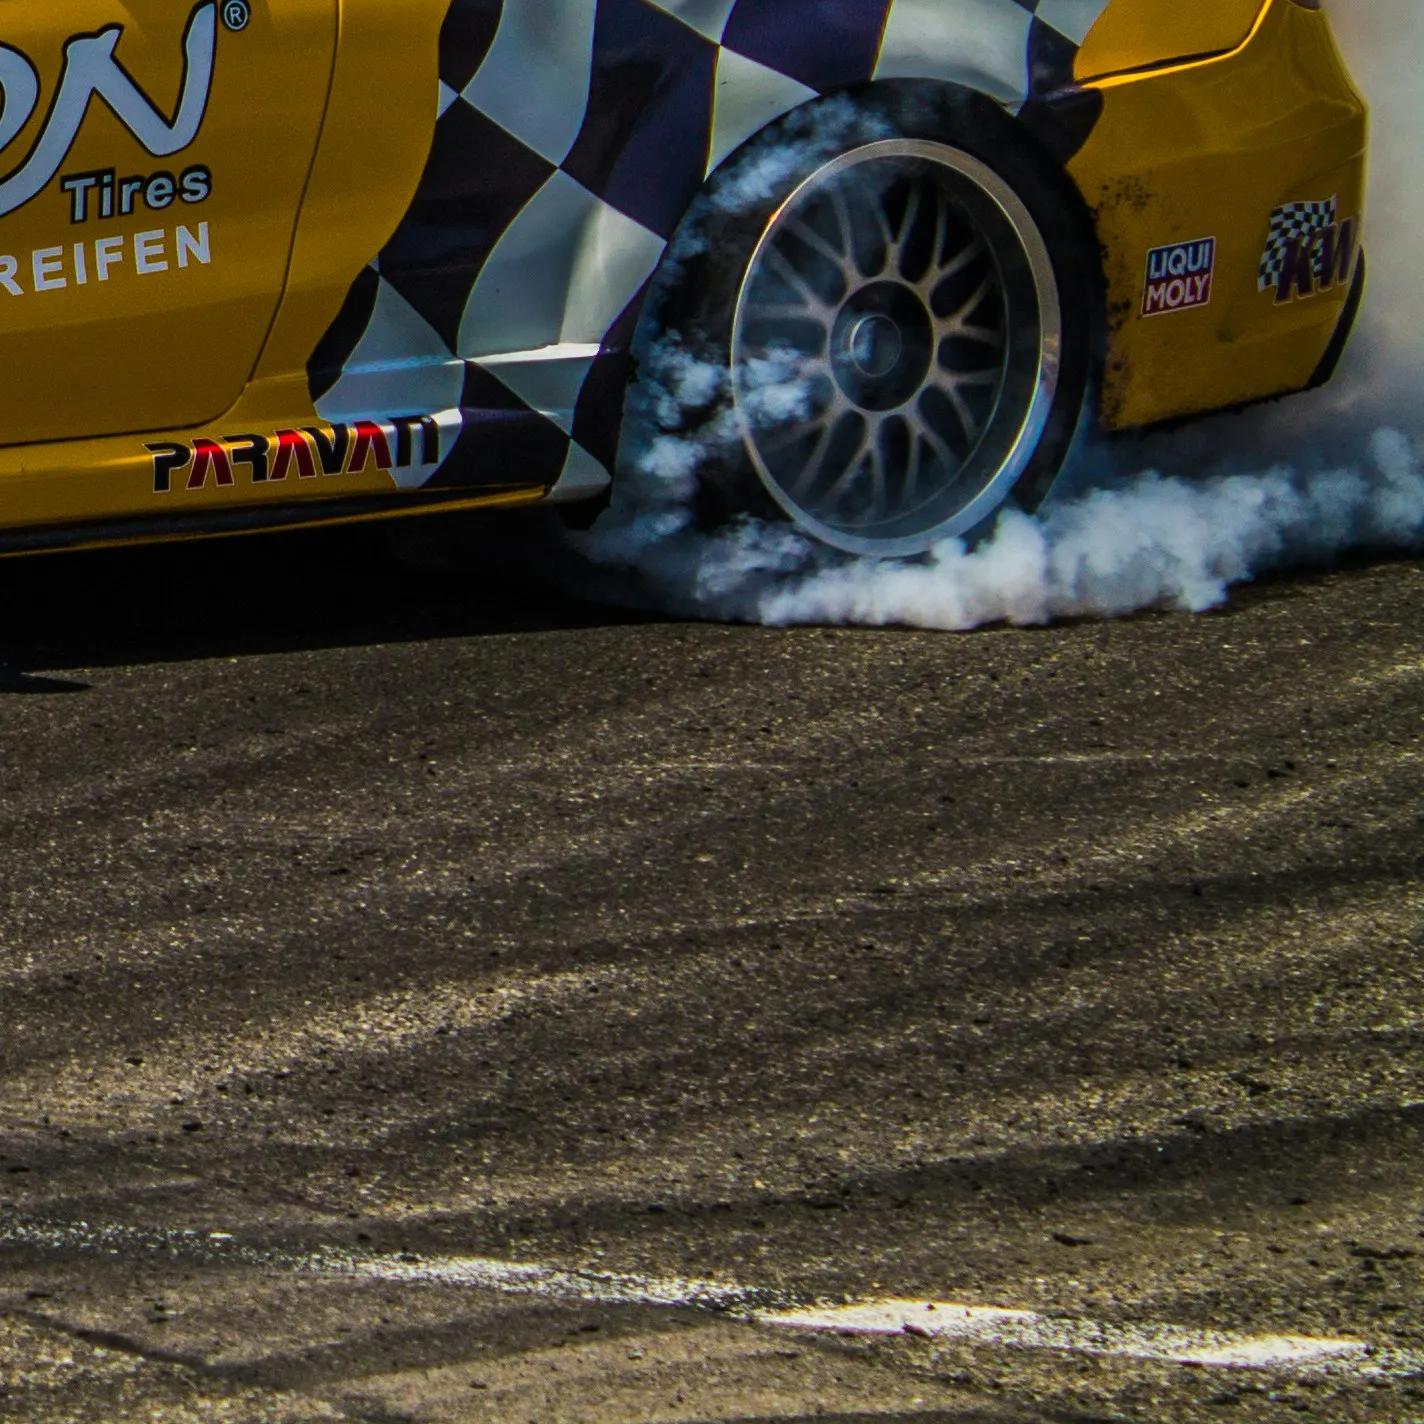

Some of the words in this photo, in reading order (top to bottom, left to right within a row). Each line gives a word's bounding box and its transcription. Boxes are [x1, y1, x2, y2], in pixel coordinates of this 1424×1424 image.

[63, 162, 212, 226] Tires
[1148, 241, 1211, 280] LIQUI
[1145, 273, 1211, 312] MOLY
